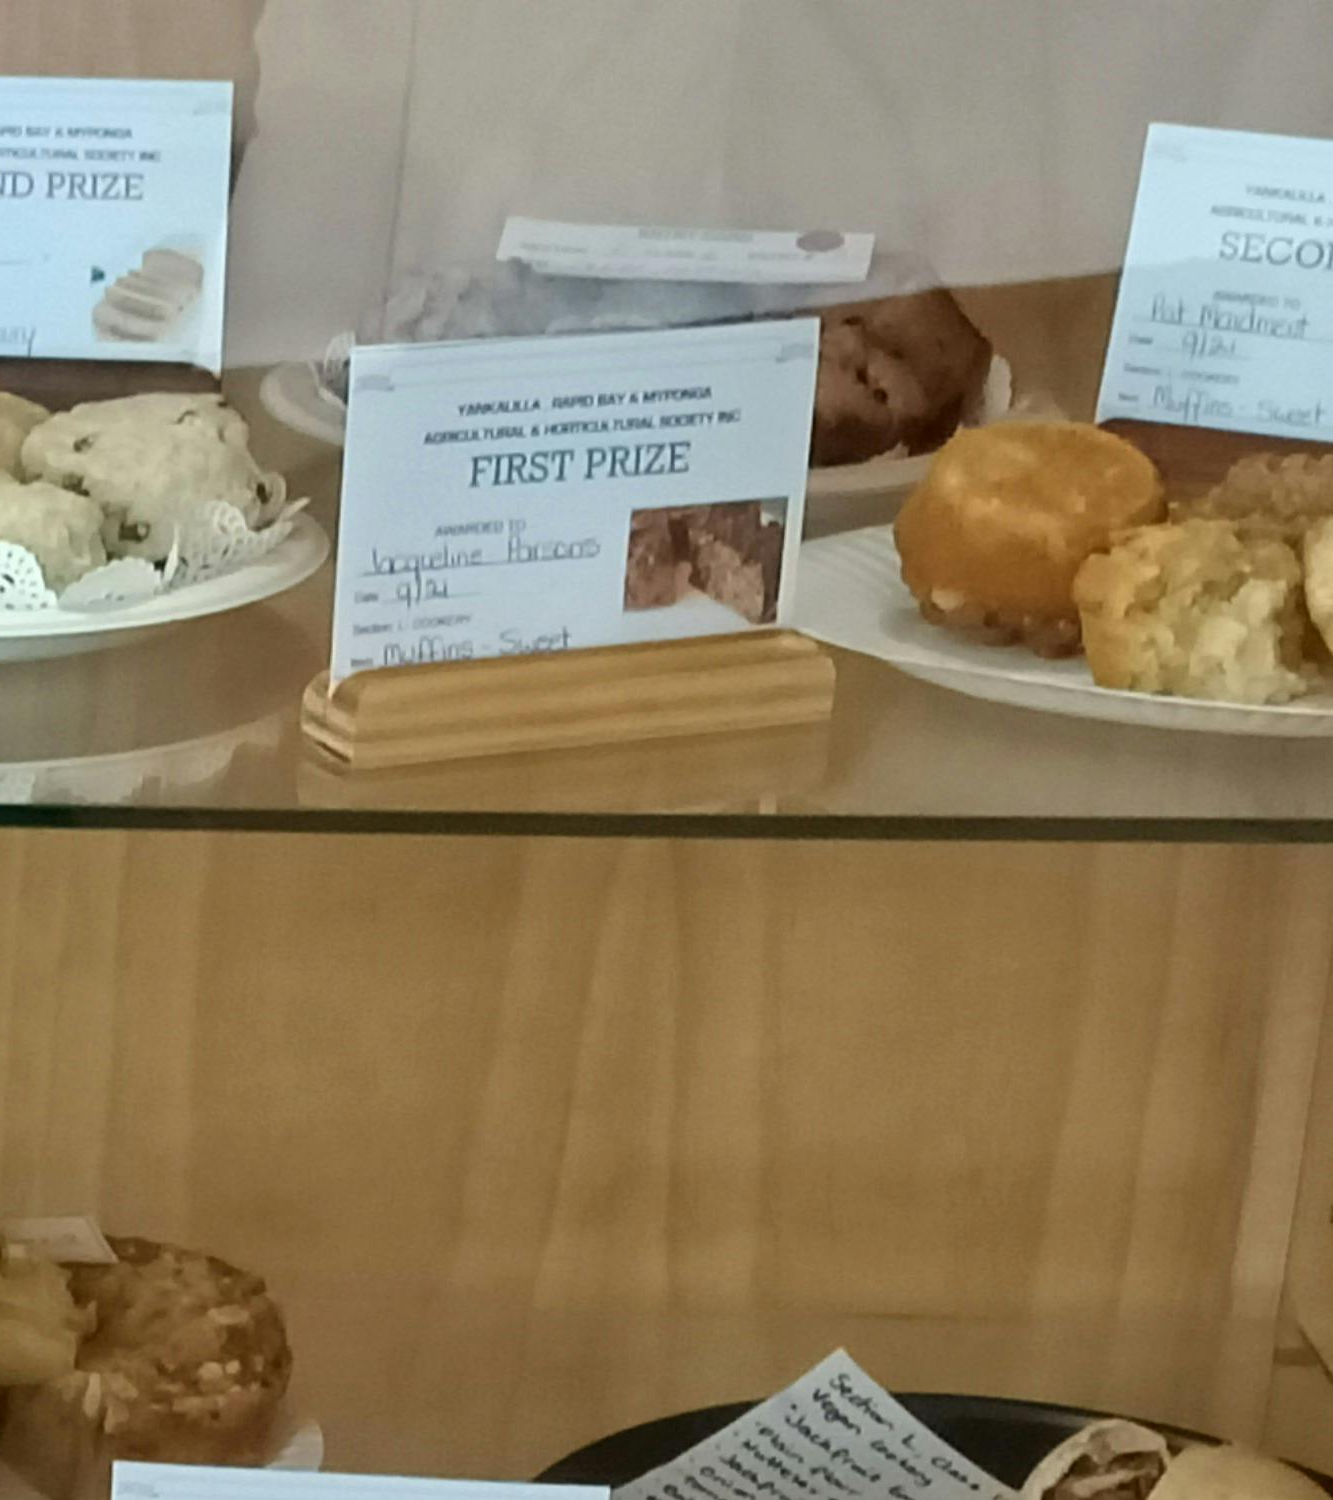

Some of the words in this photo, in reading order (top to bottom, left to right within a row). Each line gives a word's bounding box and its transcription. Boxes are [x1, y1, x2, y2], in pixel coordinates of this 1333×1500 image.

[46, 174, 143, 200] PRIZE
[597, 392, 625, 407] BAY
[469, 451, 573, 488] FIRST
[585, 442, 690, 480] PRIZE
[813, 1388, 861, 1434] Vegan
[830, 1373, 893, 1430] Section
